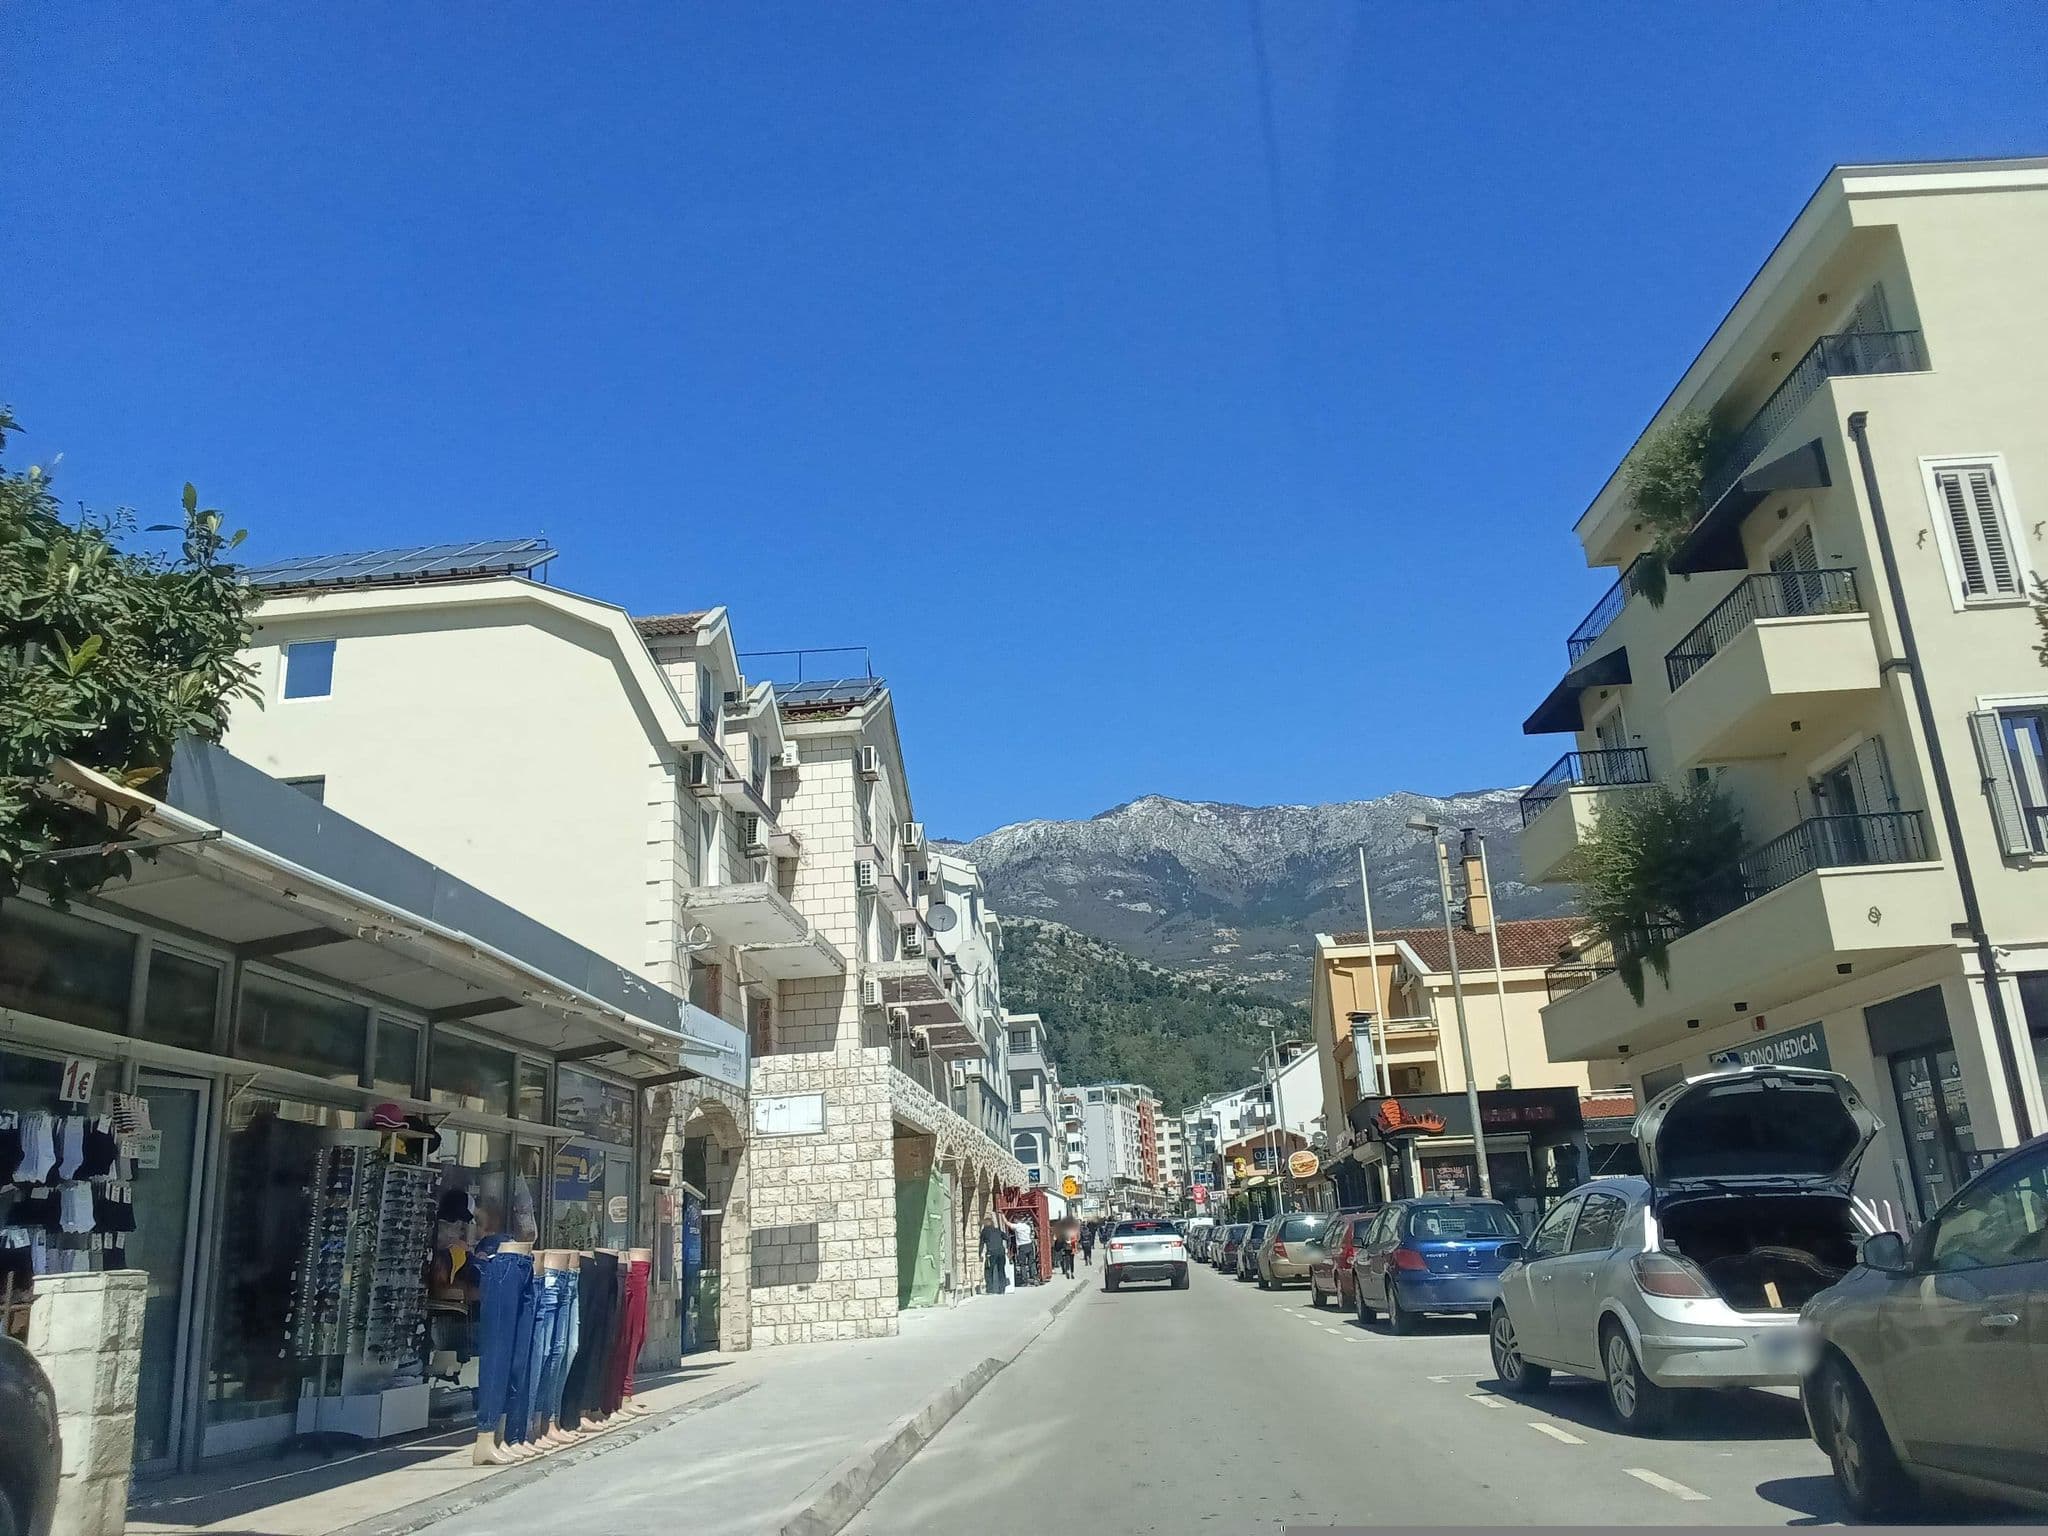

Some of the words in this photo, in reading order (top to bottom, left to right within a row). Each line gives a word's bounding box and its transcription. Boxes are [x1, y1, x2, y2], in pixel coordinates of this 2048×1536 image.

[1743, 1045, 1774, 1065] BONO
[1774, 1033, 1819, 1062] MEDICA
[67, 1060, 91, 1100] 1€
